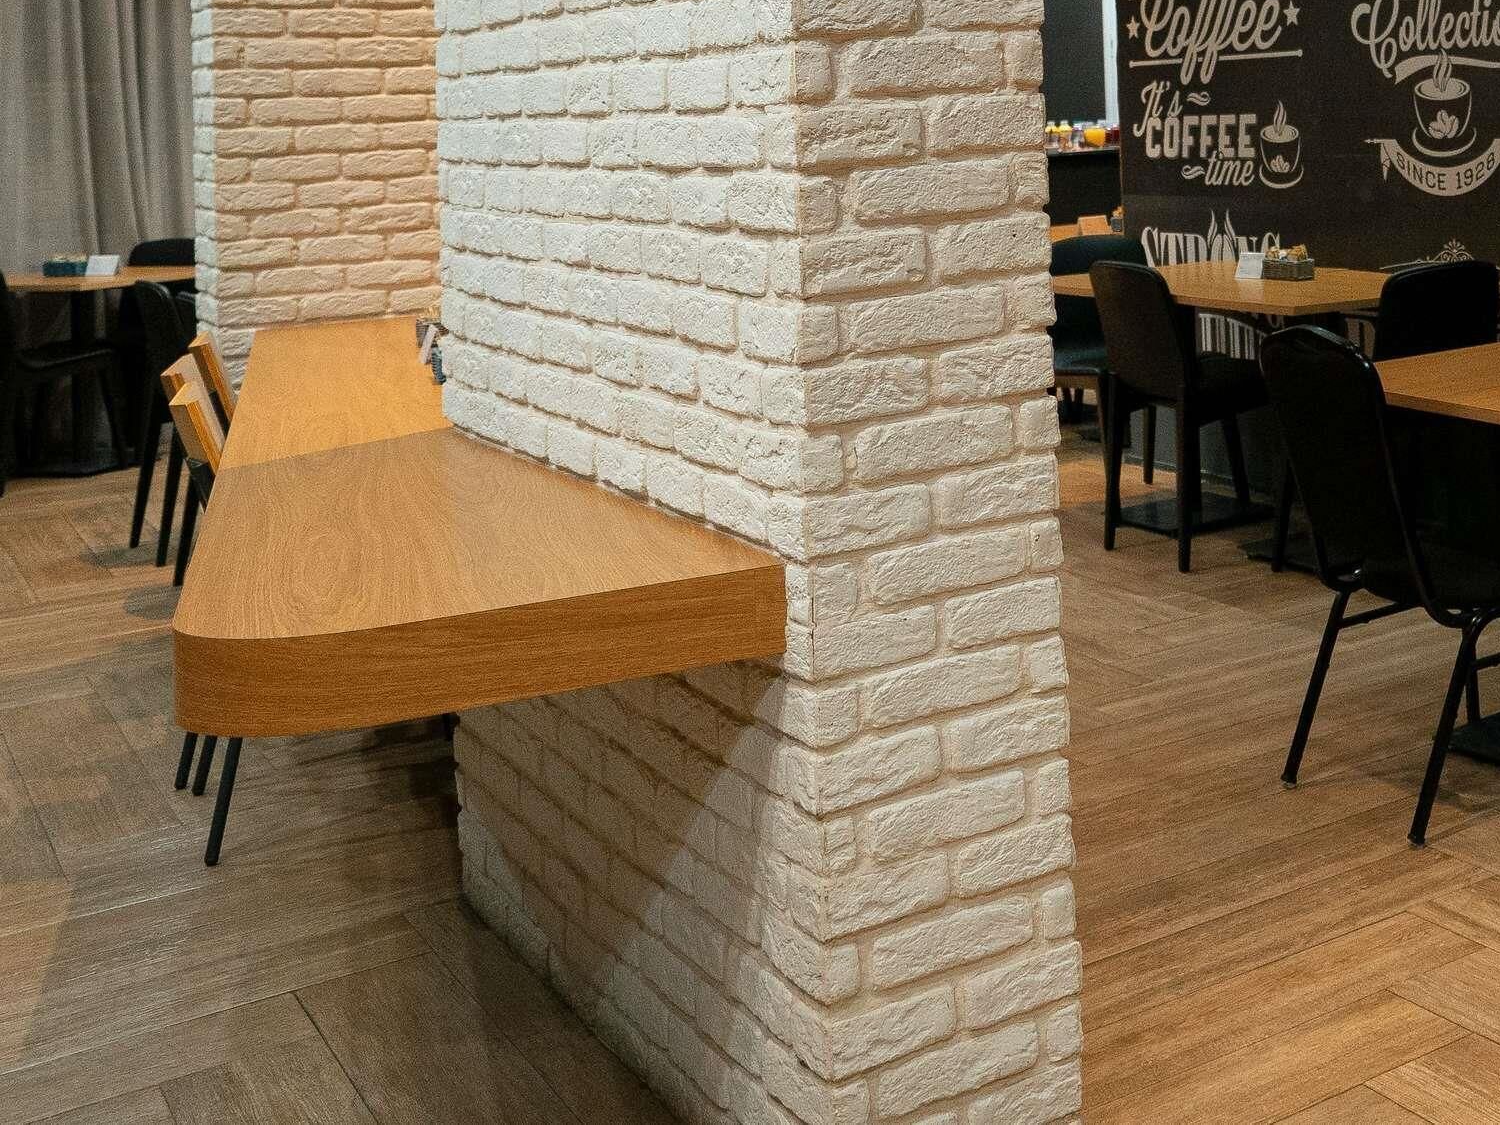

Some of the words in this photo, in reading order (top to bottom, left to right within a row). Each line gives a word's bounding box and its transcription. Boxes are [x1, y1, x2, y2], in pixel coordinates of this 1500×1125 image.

[1133, 80, 1183, 137] It's
[1145, 113, 1256, 159] COFFEE
[1204, 148, 1254, 187] time
[1397, 153, 1446, 191] SINCE
[1456, 153, 1495, 190] 1928
